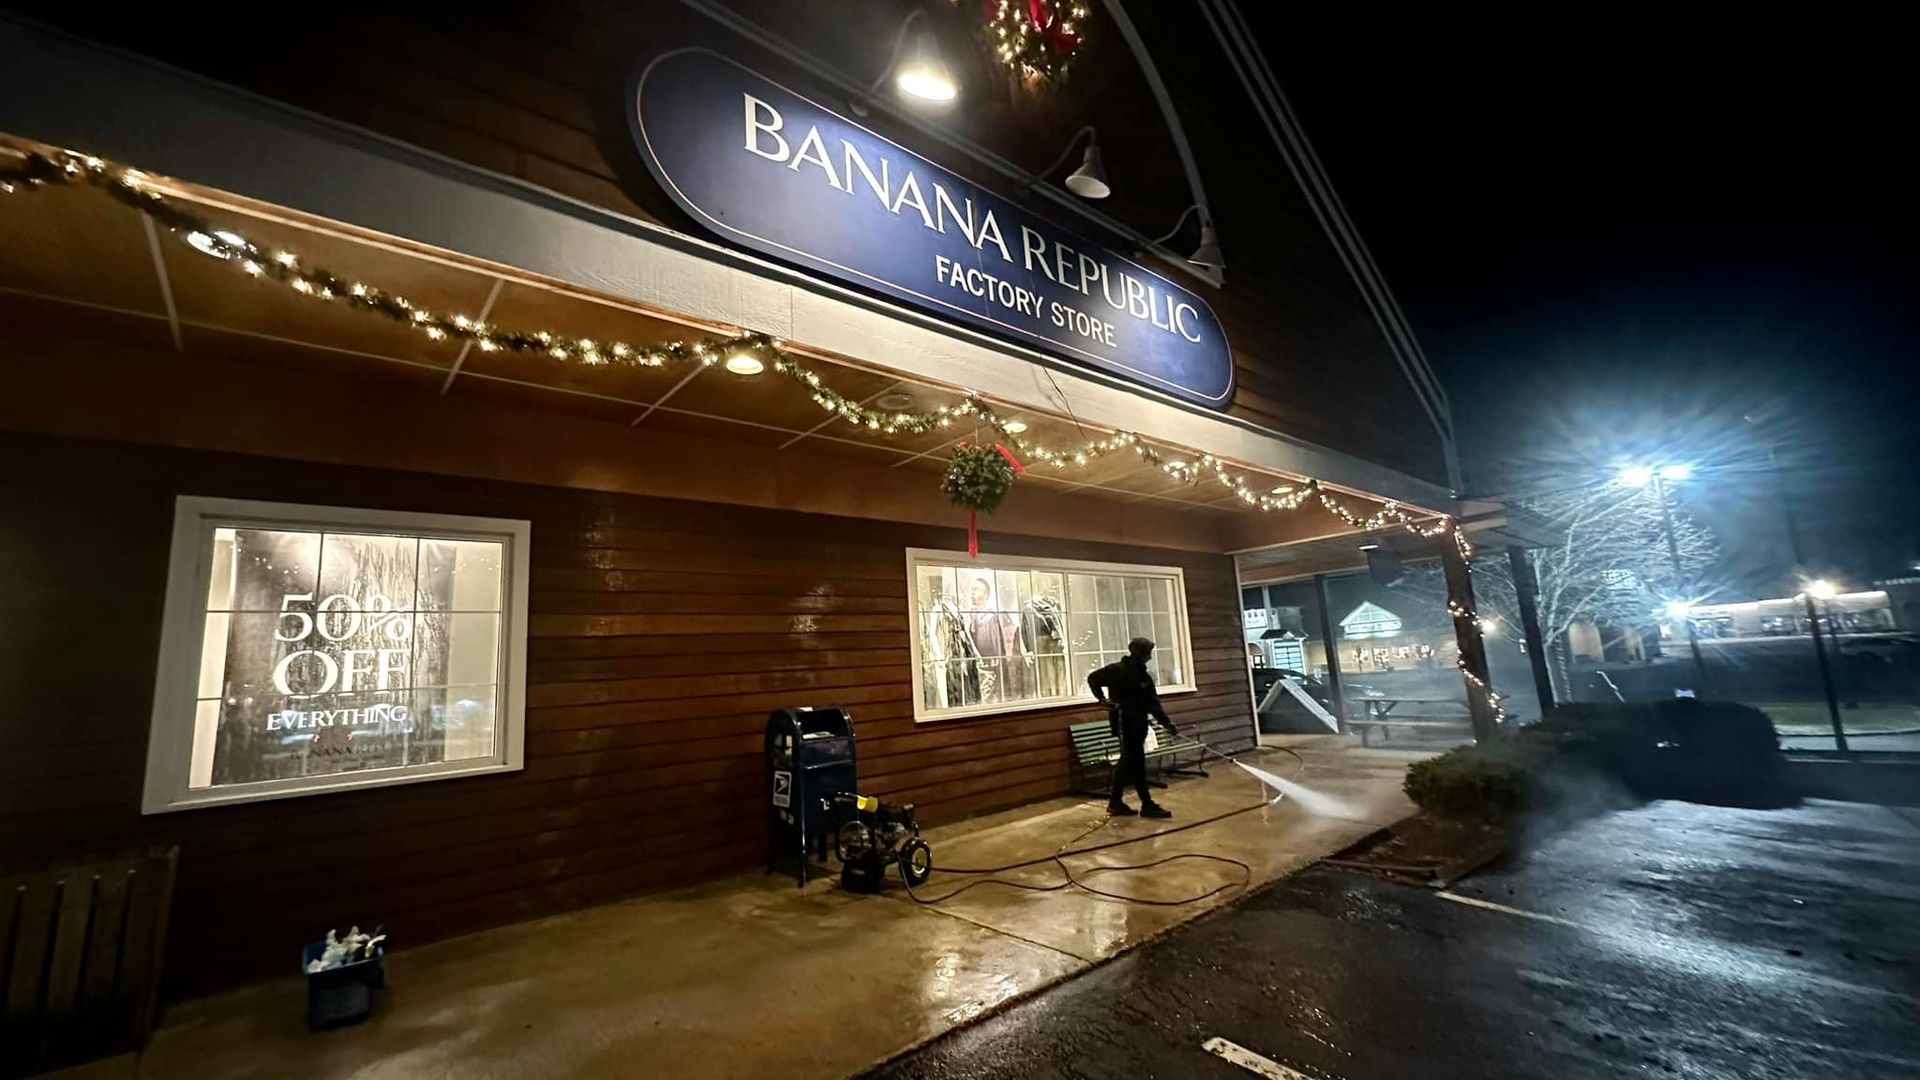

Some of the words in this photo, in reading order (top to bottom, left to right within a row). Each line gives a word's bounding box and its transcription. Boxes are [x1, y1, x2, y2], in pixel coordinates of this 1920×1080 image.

[743, 93, 1012, 263] BANANA
[1021, 226, 1202, 343] REPUBLIC
[935, 255, 1044, 321] FACTORY
[1051, 301, 1117, 348] STORE
[274, 592, 412, 642] 50%
[273, 649, 412, 699] OFF
[267, 706, 408, 731] EVERYTHING
